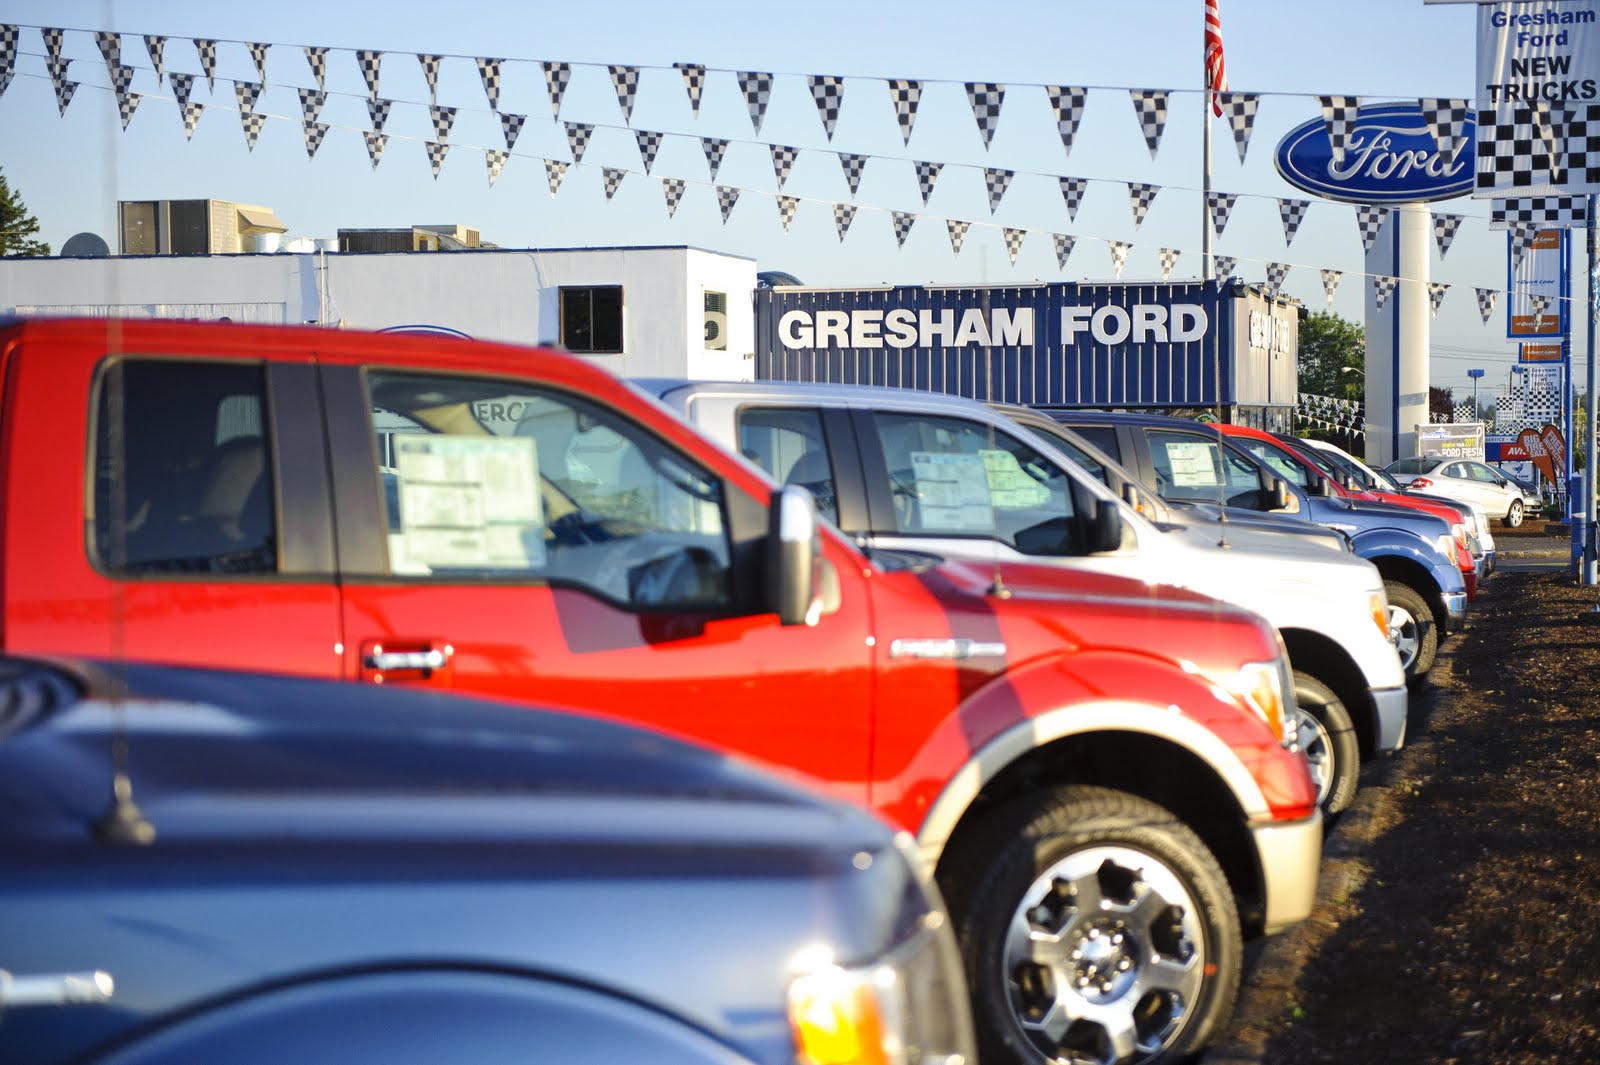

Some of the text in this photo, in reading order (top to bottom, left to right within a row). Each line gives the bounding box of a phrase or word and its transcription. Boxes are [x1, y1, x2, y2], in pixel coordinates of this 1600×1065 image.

[1491, 9, 1595, 27] Gresham
[1517, 29, 1568, 48] Ford
[1511, 55, 1571, 77] NEW
[1486, 79, 1597, 103] TRUCKS
[1327, 126, 1468, 181] Ford
[778, 308, 1033, 349] GRESHAM
[1061, 304, 1208, 345] FORD
[1523, 434, 1540, 445] BIG
[1524, 442, 1544, 452] TIRE
[1546, 429, 1565, 454] FREE
[1442, 448, 1461, 458] FORD
[1530, 449, 1548, 457] SALE
